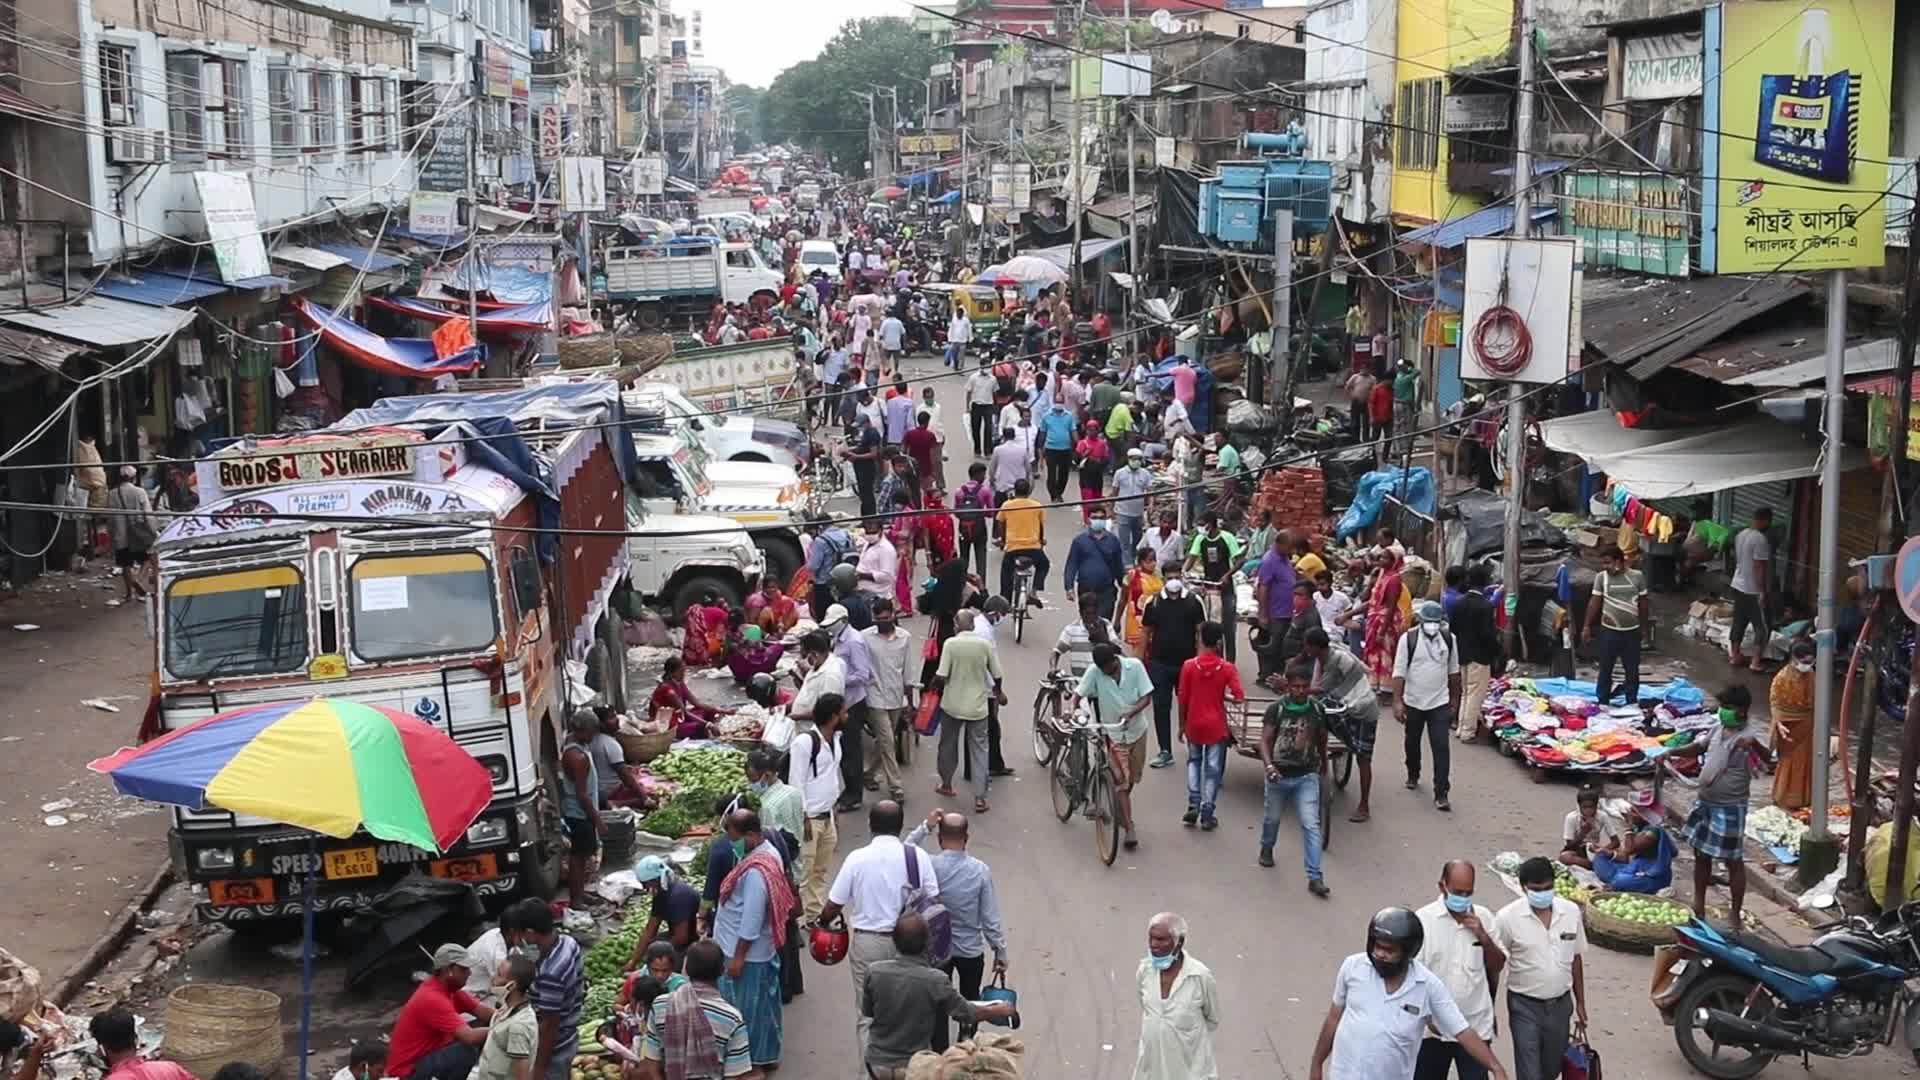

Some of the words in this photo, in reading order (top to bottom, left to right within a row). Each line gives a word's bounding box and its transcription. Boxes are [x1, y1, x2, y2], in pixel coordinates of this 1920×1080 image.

[1745, 207, 1794, 233] শীঘ্রই
[1744, 236, 1797, 253] শিয়ালদহ
[219, 458, 282, 485] GOODS
[337, 447, 408, 475] CARRIER
[297, 501, 337, 513] PERMIT
[272, 855, 322, 874] SPEED
